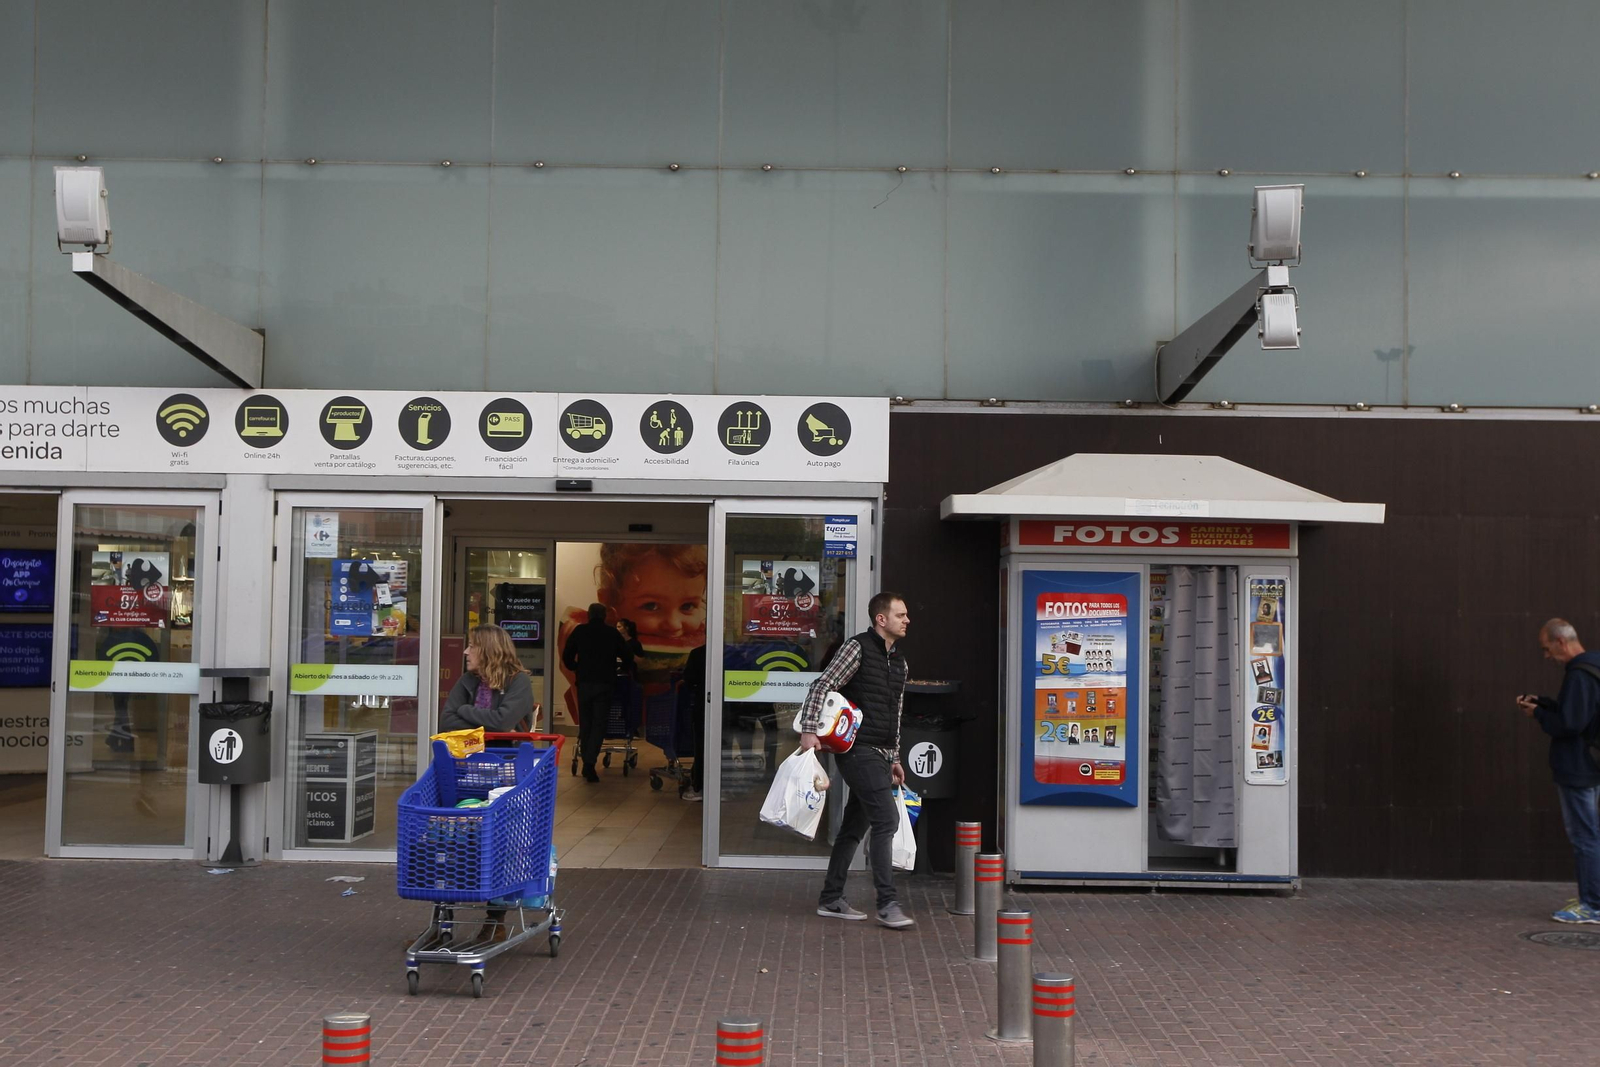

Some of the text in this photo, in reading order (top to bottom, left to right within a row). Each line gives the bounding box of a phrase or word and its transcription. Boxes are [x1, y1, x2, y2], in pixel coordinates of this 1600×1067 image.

[24, 396, 110, 414] muchas
[408, 404, 442, 412] Servicios
[8, 422, 56, 440] para
[61, 419, 120, 438] darte
[1, 441, 62, 460] enida
[346, 462, 376, 470] catálogo
[552, 456, 580, 464] Entrega
[1054, 525, 1180, 544] FOTOS
[1251, 584, 1284, 593] FOTOS
[1045, 602, 1088, 617] FOTOS
[24, 655, 44, 664] más
[1041, 653, 1070, 675] 5€
[1258, 708, 1276, 721] 2€
[1040, 720, 1069, 742] 2€
